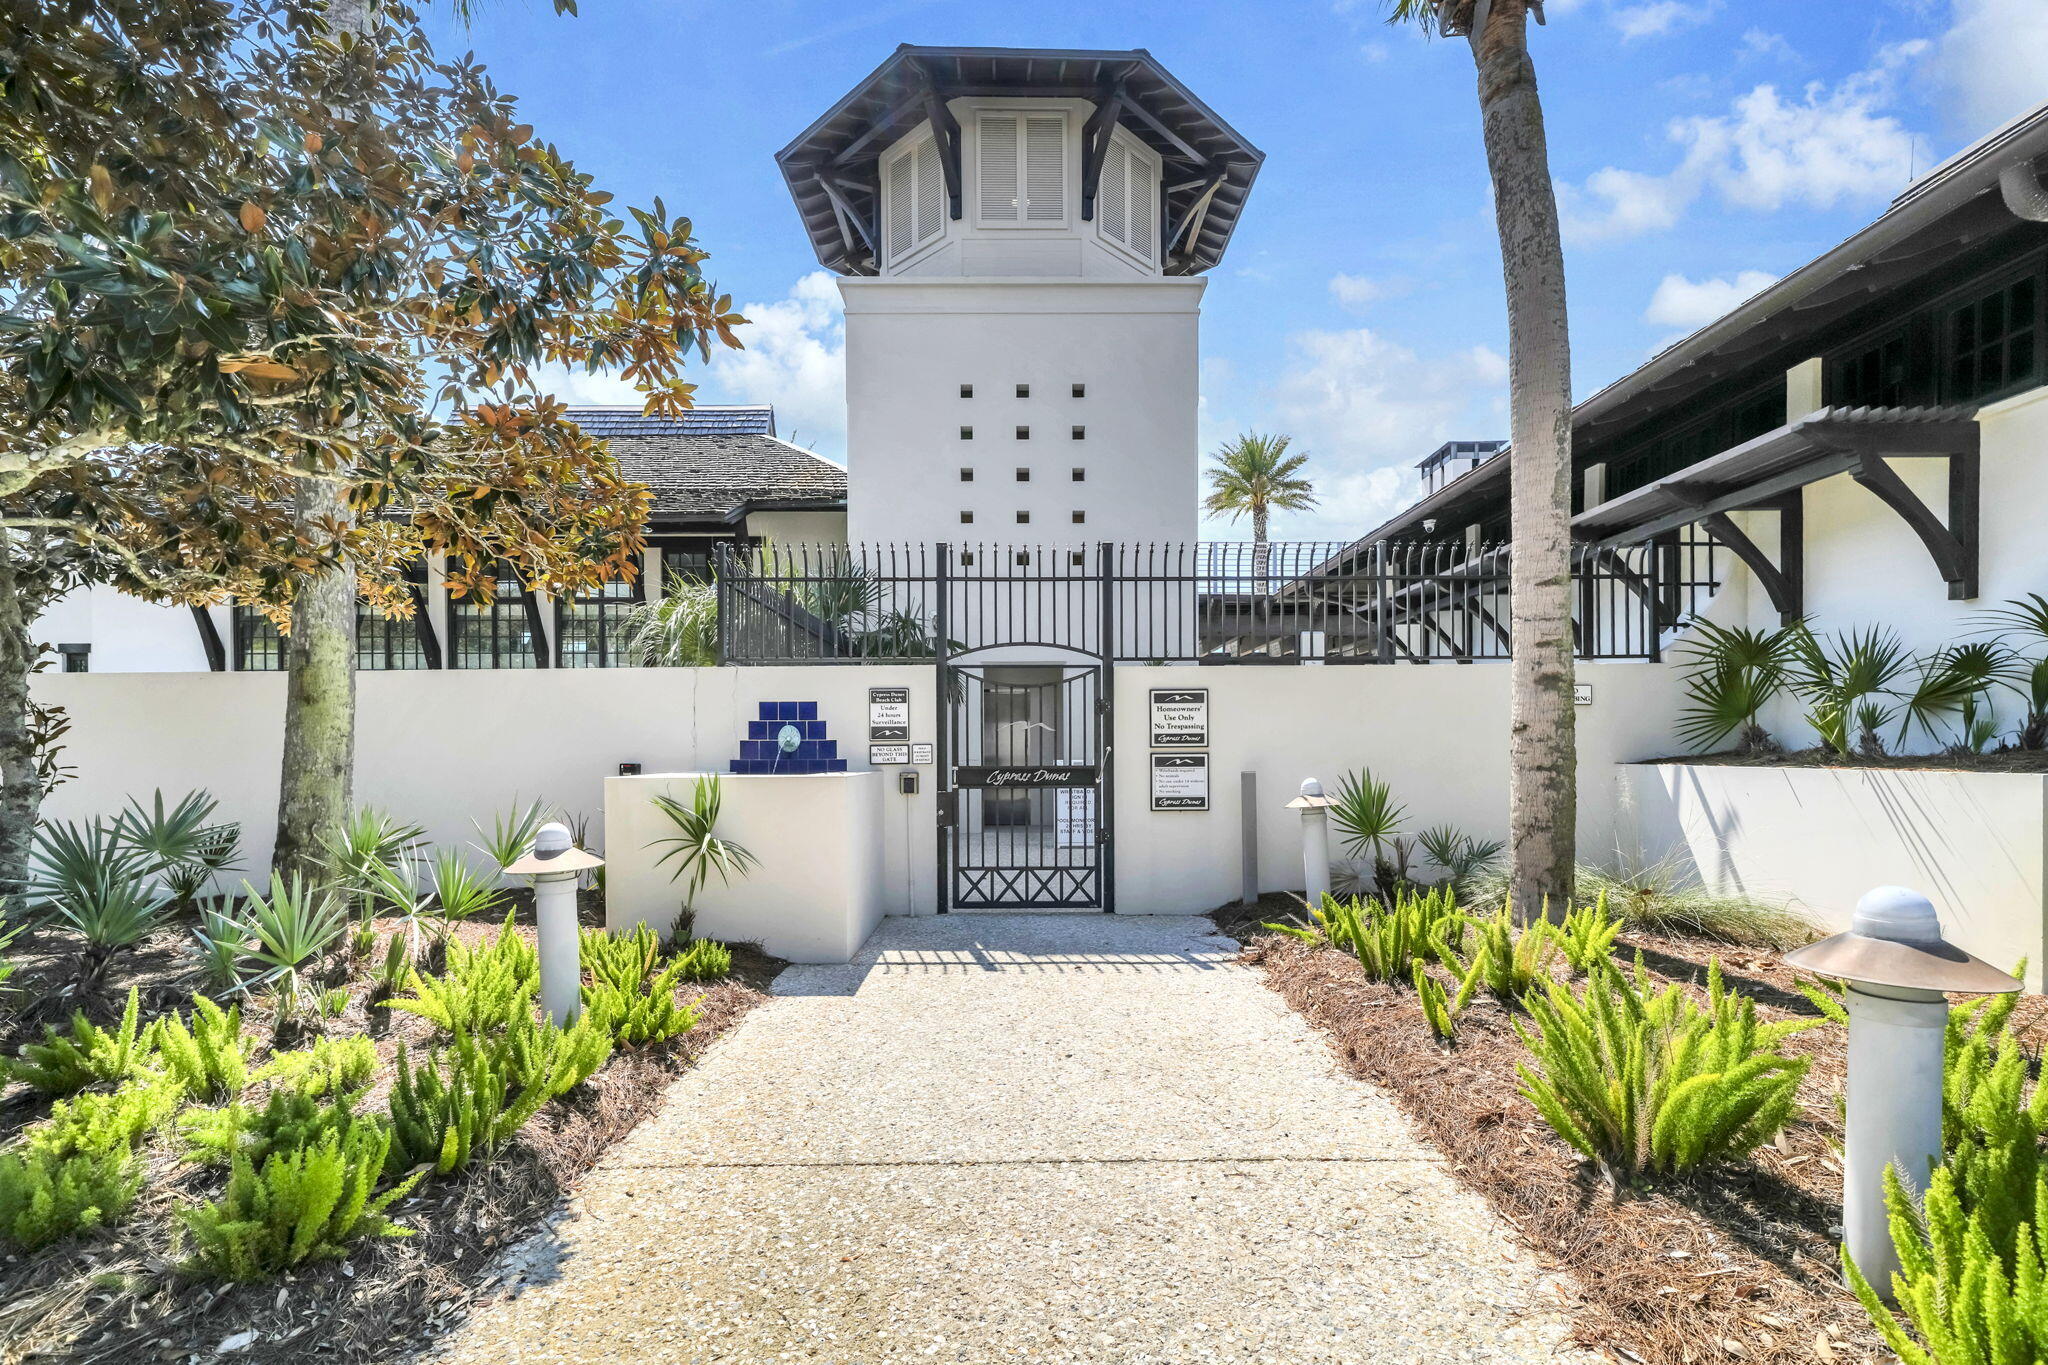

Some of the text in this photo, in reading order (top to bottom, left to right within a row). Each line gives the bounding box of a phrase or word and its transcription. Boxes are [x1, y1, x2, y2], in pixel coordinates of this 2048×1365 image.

[1167, 722, 1205, 731] Trespassing
[1158, 734, 1201, 743] Cypress Dunes
[986, 769, 1071, 786] Cypress Dunes
[1158, 798, 1181, 807] Cypress
